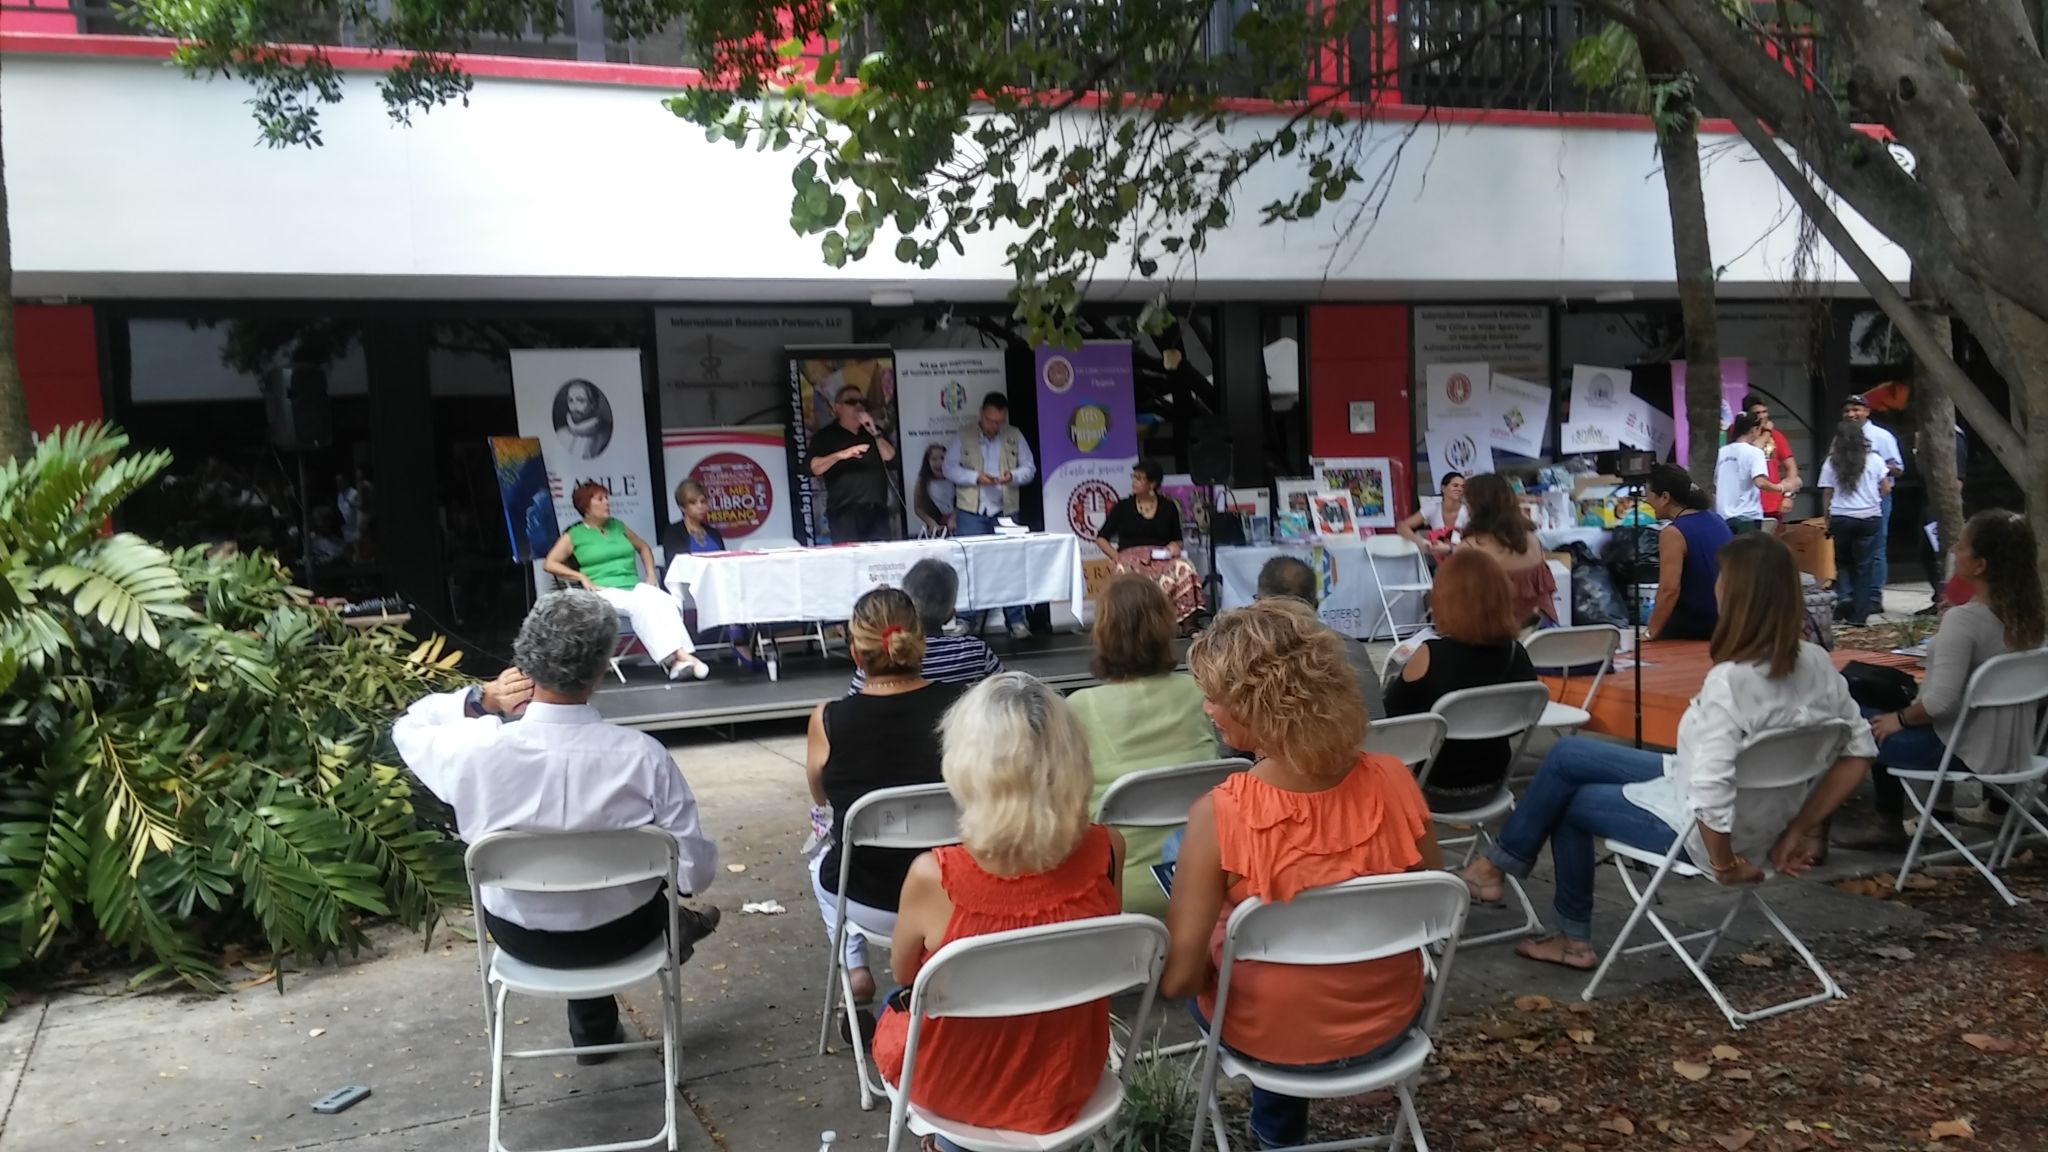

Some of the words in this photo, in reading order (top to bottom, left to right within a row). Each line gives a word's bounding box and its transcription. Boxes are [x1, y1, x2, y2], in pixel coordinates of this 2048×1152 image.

[670, 317, 732, 327] International
[736, 317, 779, 327] Research
[782, 317, 823, 328] Partners,
[826, 317, 843, 327] LLC
[708, 486, 726, 497] DEL
[712, 495, 756, 511] LIBRO
[707, 510, 757, 522] HISPANO
